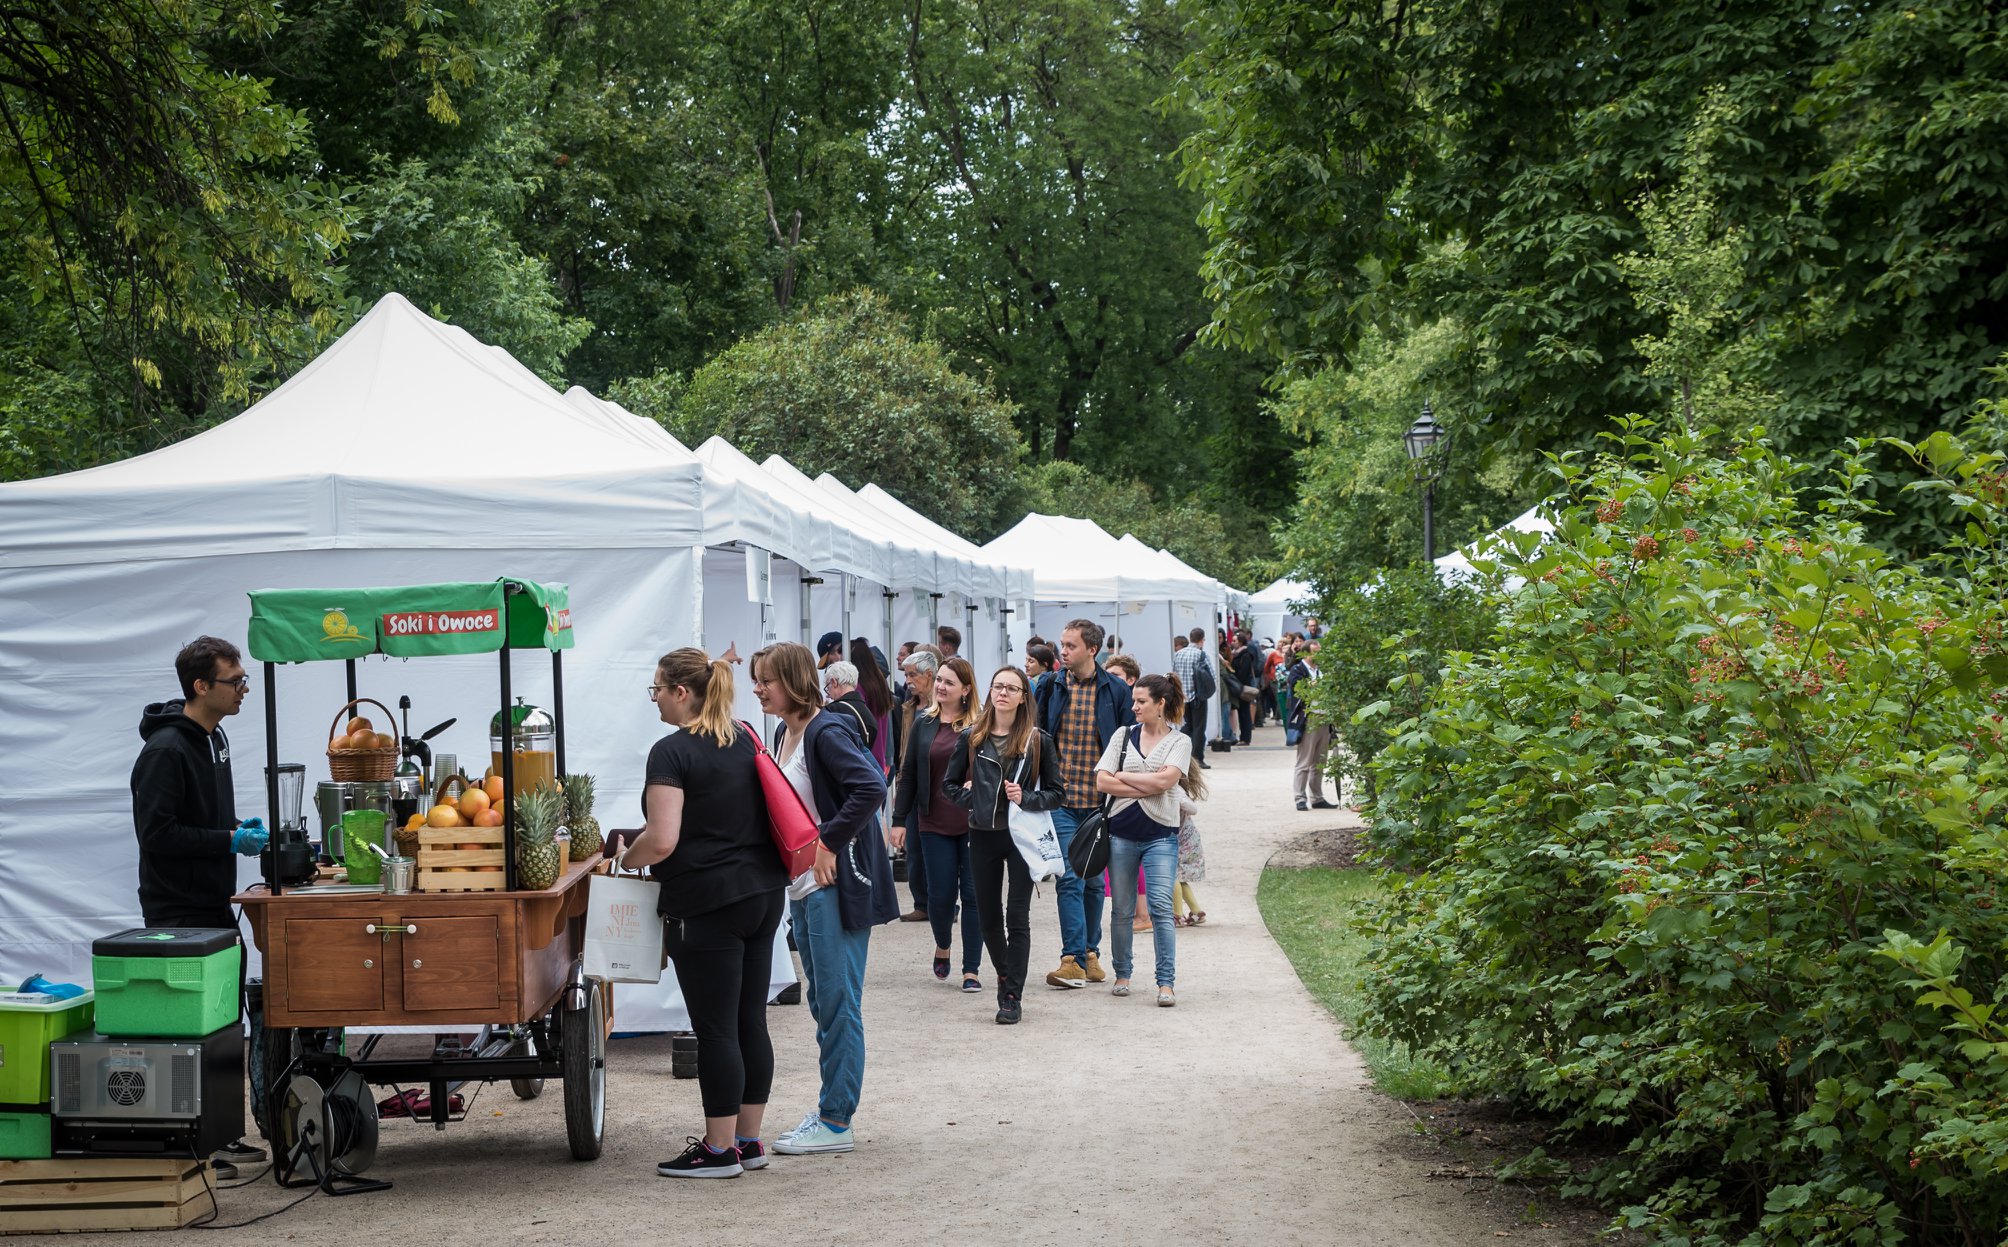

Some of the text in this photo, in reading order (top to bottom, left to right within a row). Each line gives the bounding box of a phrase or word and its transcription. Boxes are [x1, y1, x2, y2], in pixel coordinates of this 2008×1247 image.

[389, 614, 493, 634] Soki i Owoce
